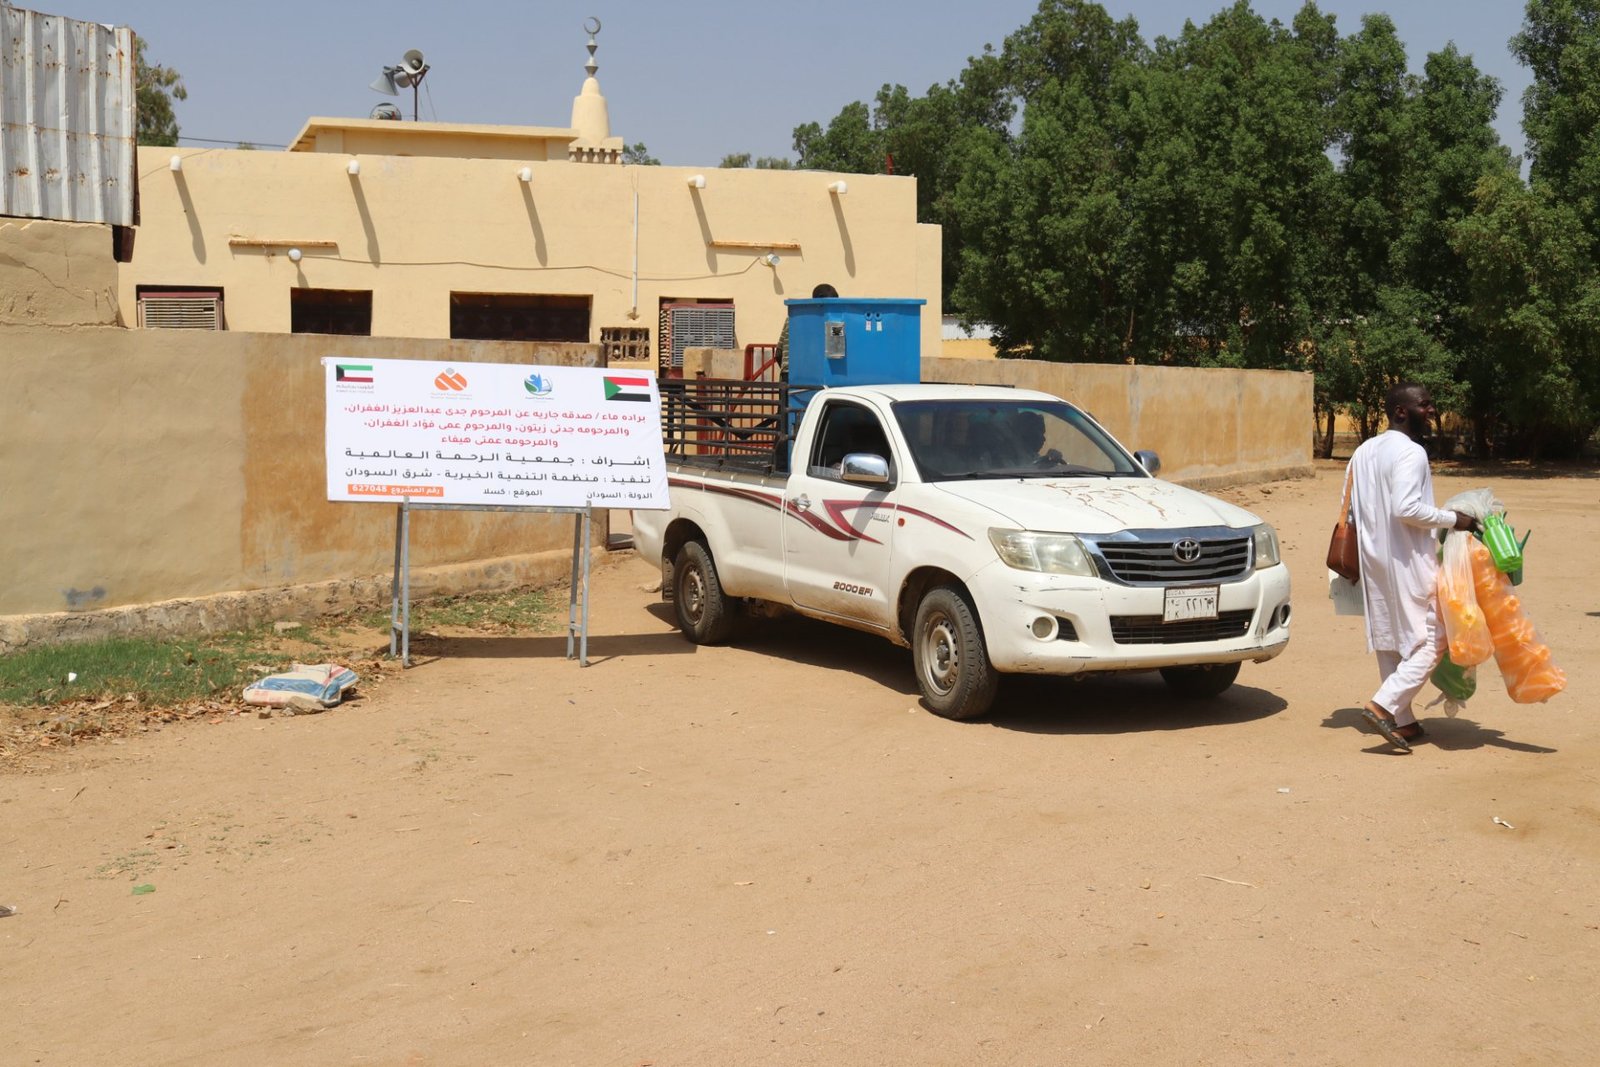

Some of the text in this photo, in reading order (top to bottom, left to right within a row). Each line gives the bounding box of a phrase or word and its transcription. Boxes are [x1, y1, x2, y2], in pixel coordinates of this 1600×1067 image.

[515, 410, 529, 418] عن
[533, 410, 558, 420] جاريه
[464, 422, 512, 431] والمرحوم
[577, 426, 629, 436] والمرحومه
[441, 435, 471, 445] هيفاء
[505, 438, 558, 447] والمرحومه
[345, 448, 429, 460] العالمية
[435, 450, 499, 462] الرحمة
[506, 452, 575, 466] جمعية
[592, 456, 650, 468] إشراف
[345, 468, 397, 477] السودان
[402, 468, 432, 478] شرق
[445, 470, 493, 480] الخيرية
[498, 471, 547, 482] التنمية
[552, 472, 599, 483] منظمة
[611, 476, 651, 485] تنفيذ
[390, 486, 424, 495] المشروع
